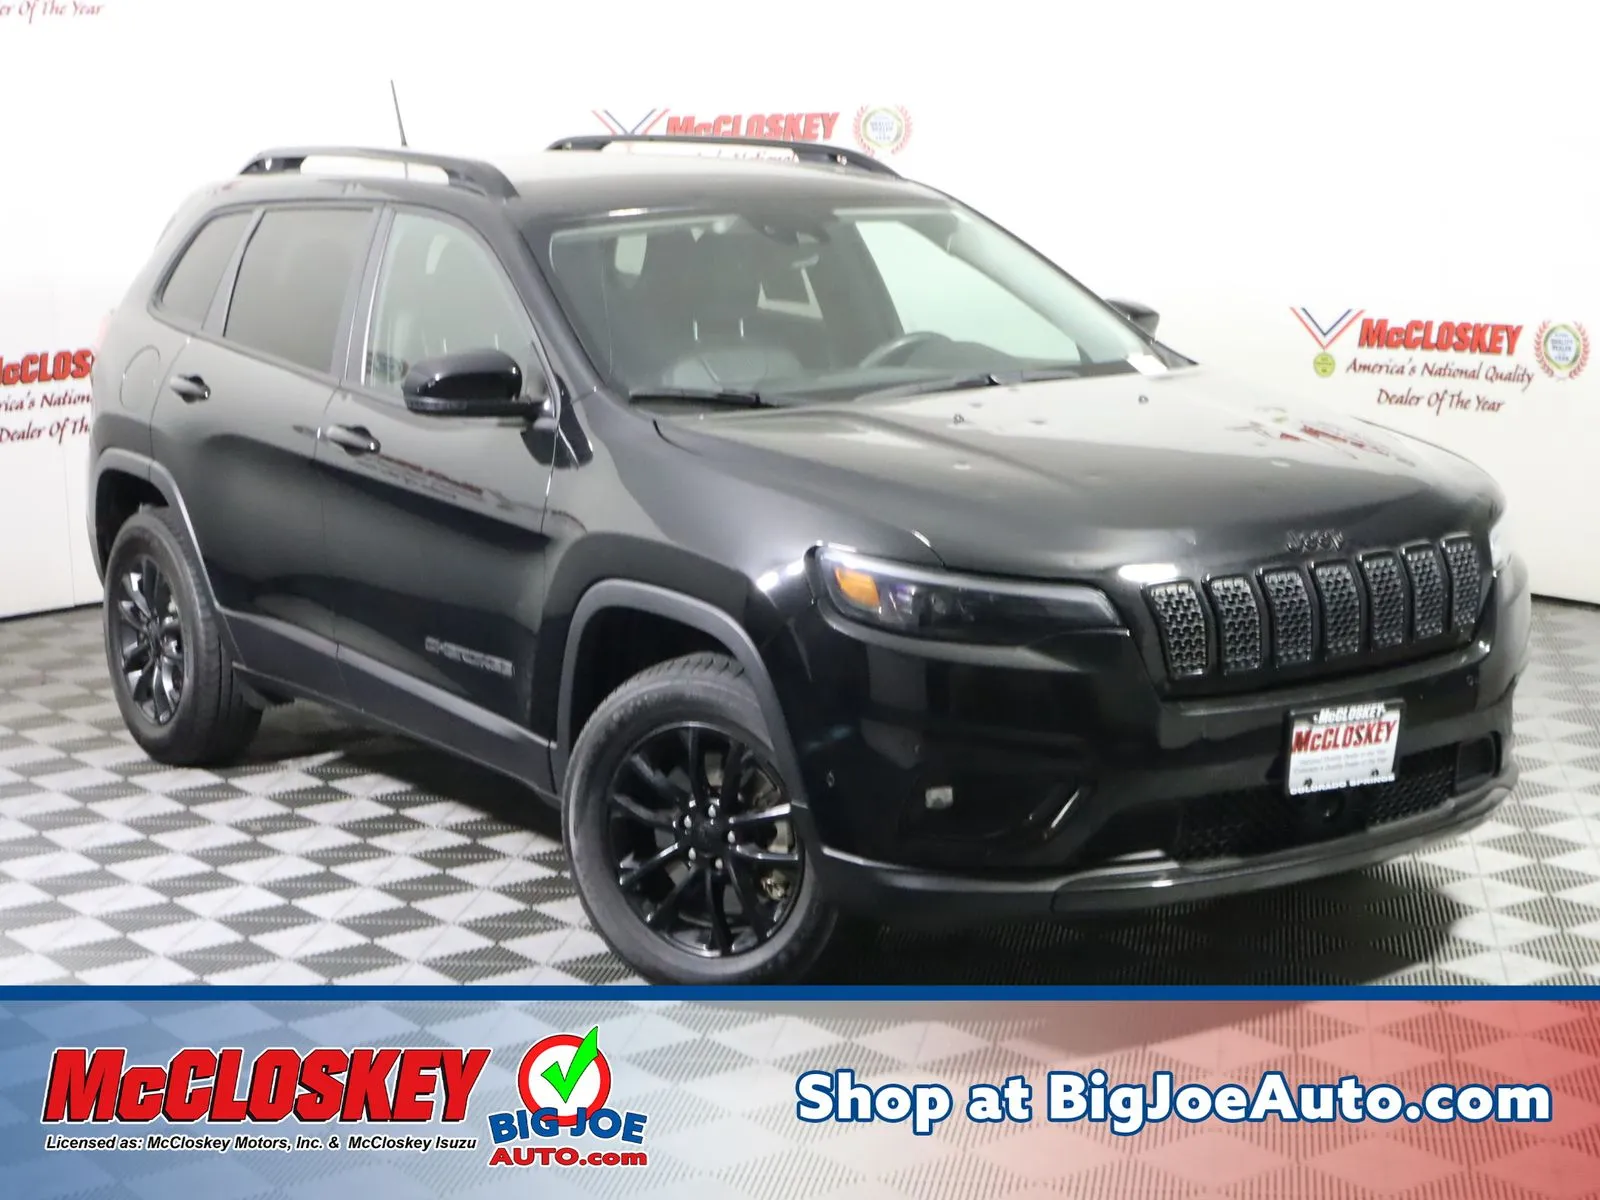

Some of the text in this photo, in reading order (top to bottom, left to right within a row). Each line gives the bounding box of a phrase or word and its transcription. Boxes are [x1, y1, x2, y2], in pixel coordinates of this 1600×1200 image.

[666, 112, 839, 141] McCLOSKEY
[1357, 318, 1523, 356] McCLOSKEY
[0, 349, 94, 385] cCLOS
[1346, 357, 1416, 375] America's
[1420, 361, 1483, 380] National
[1485, 364, 1534, 391] Quality
[40, 388, 92, 408] Nation
[1376, 388, 1506, 416] Dealer Of The Year
[0, 421, 45, 443] Dealer
[49, 417, 70, 445] Of
[1291, 720, 1397, 753] McCLOSKEY
